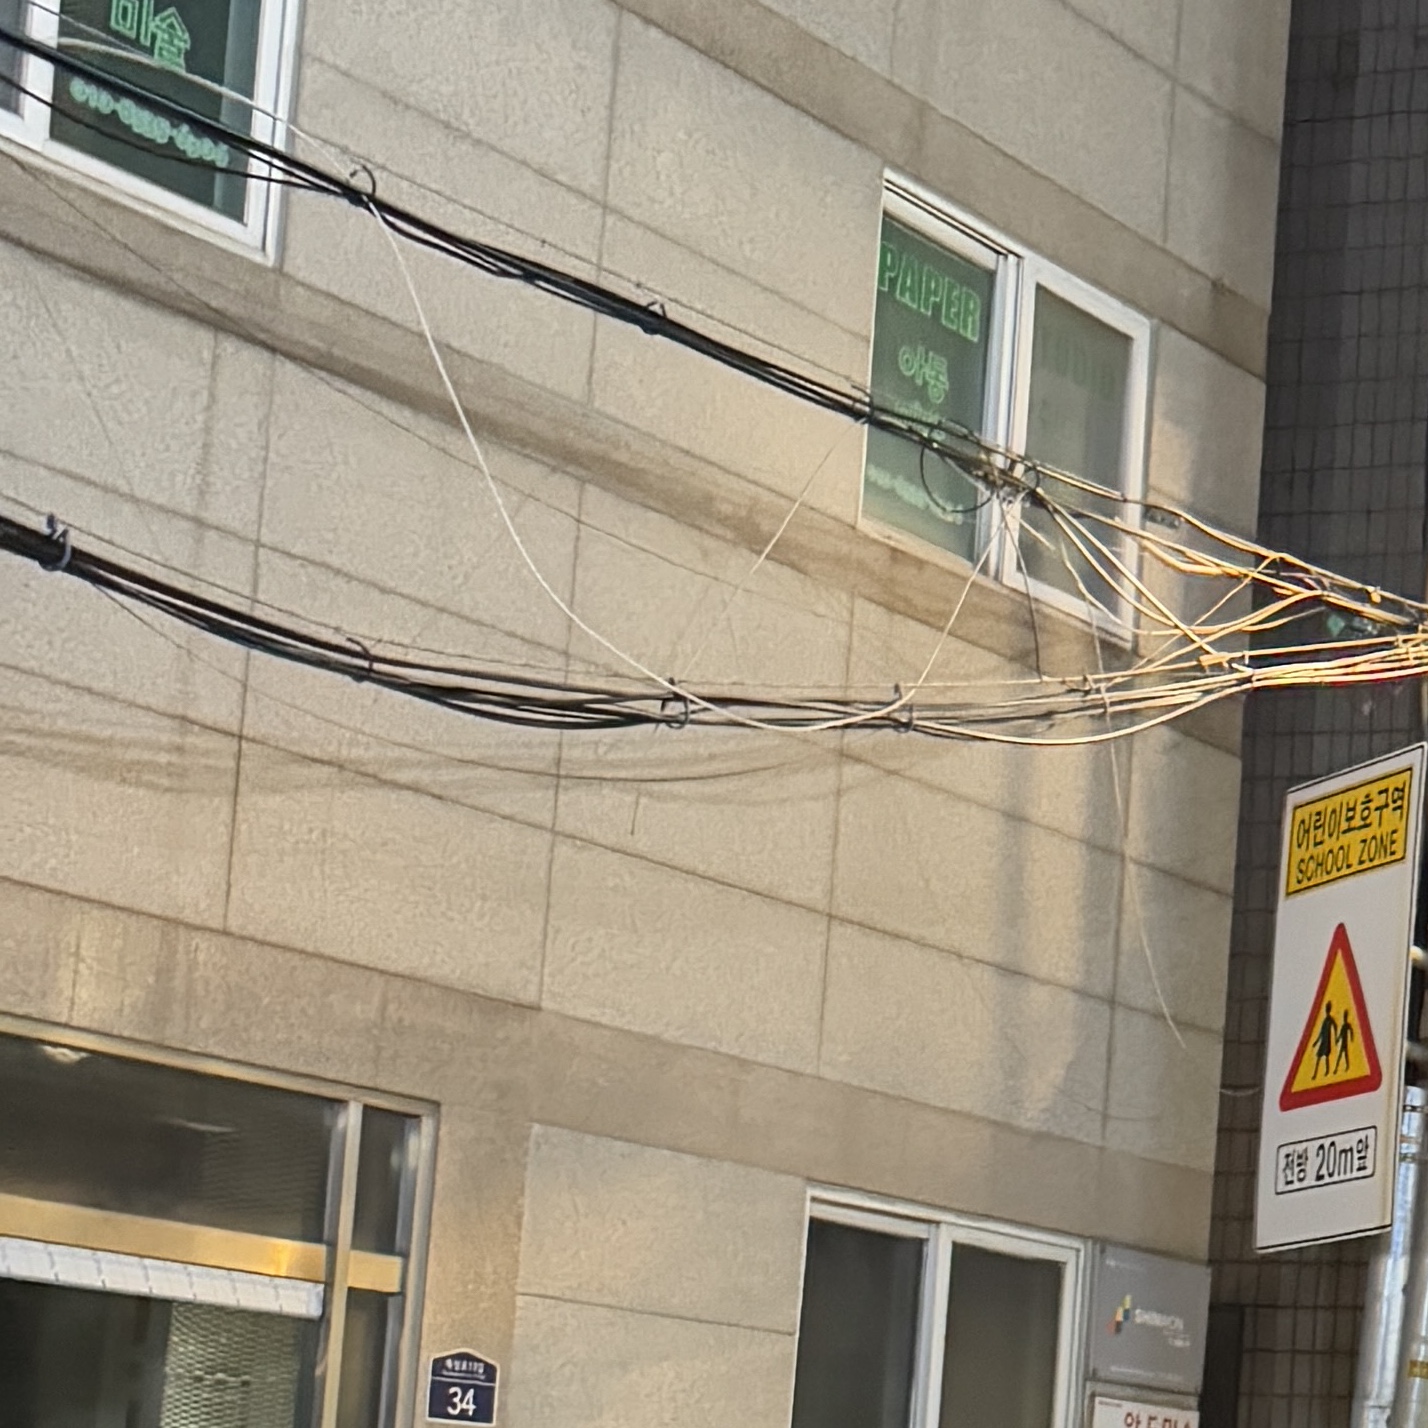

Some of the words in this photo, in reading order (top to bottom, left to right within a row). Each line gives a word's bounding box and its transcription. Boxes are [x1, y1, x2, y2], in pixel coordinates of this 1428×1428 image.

[878, 241, 982, 344] PAPER
[1296, 780, 1407, 852] 어린이보호구역
[1296, 844, 1353, 885] SCHOOL
[1358, 828, 1398, 866] ZONE
[1282, 1146, 1309, 1186] 전방
[1314, 1134, 1369, 1182] 20m앞
[446, 1386, 477, 1416] 34
